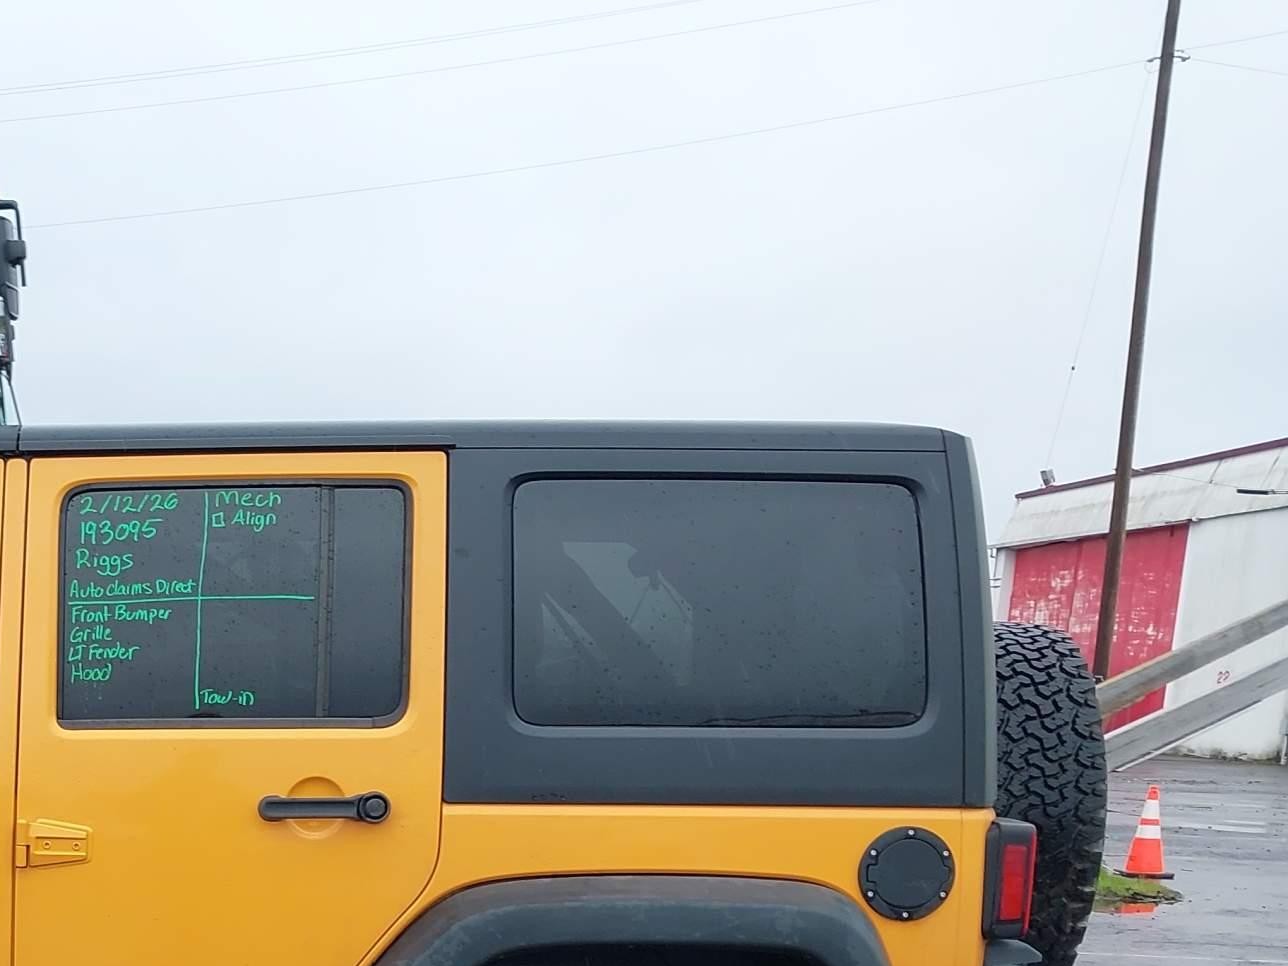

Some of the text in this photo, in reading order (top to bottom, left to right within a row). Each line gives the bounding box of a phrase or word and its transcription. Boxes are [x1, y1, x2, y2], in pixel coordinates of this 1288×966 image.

[79, 492, 179, 515] 2/12/26
[215, 490, 282, 508] Mech
[79, 517, 164, 545] 193095
[231, 509, 277, 532] Align
[75, 547, 135, 576] Riggs
[154, 577, 197, 596] Direct
[70, 603, 173, 625] Front Bumper
[69, 624, 114, 643] Grille
[88, 641, 142, 662] Fender
[70, 661, 113, 685] Hood
